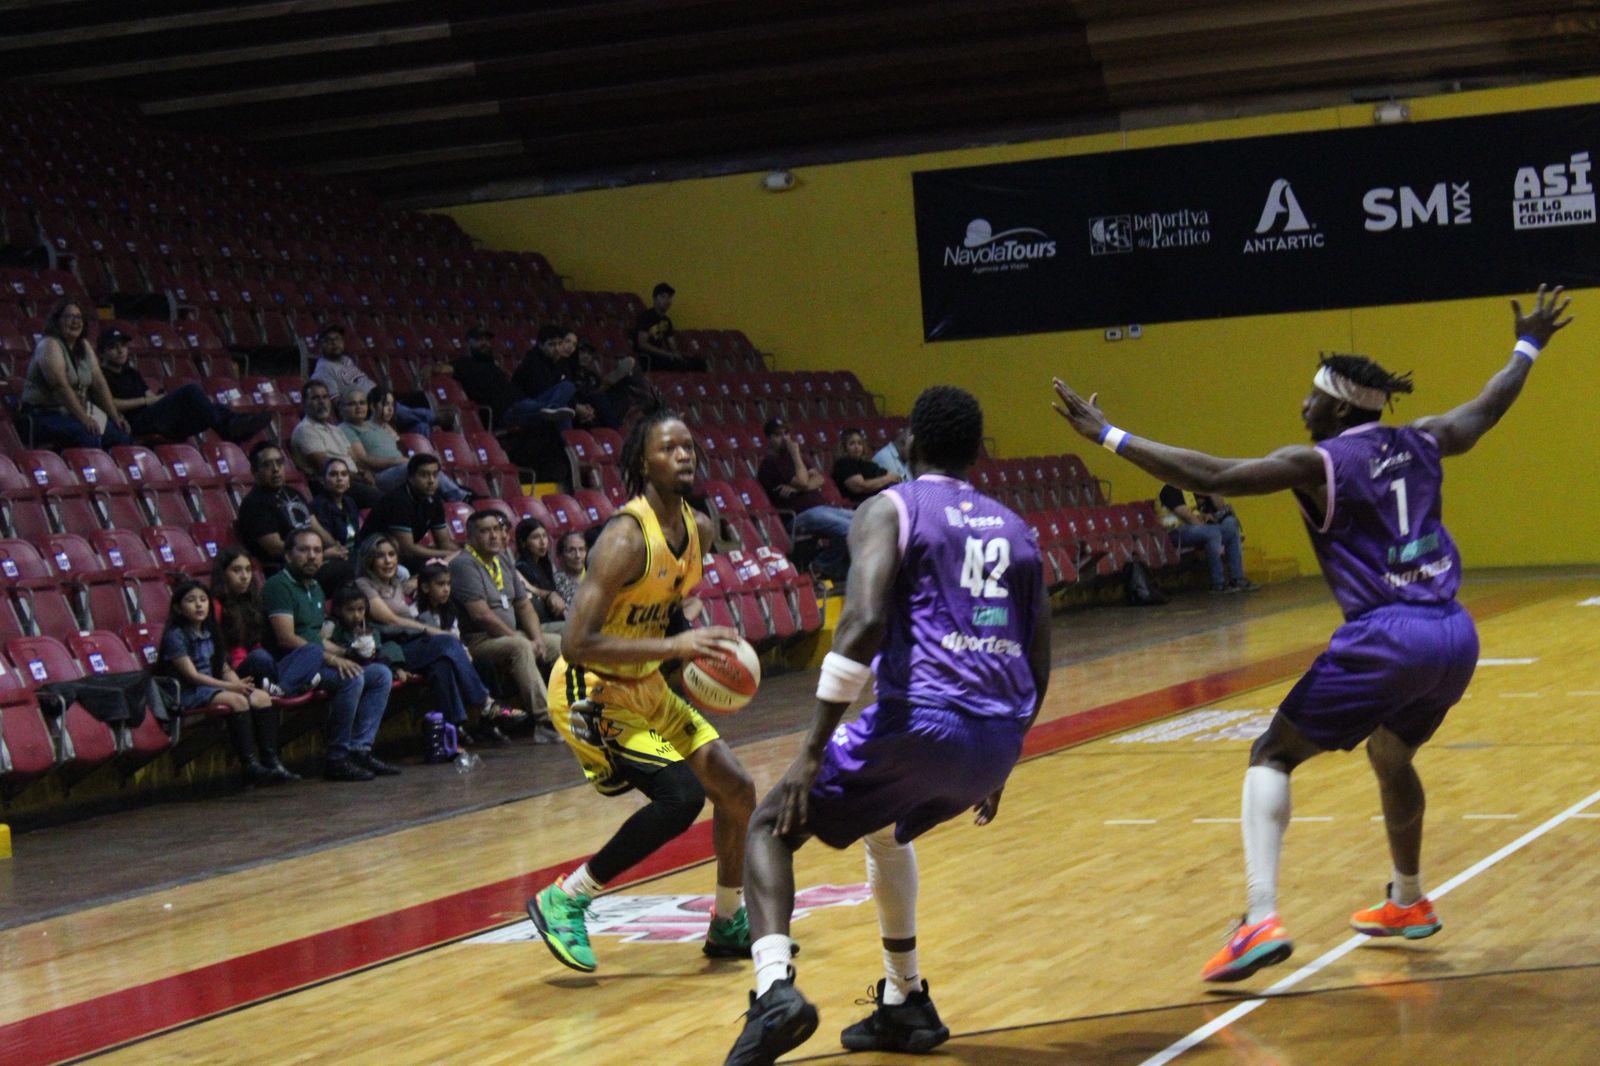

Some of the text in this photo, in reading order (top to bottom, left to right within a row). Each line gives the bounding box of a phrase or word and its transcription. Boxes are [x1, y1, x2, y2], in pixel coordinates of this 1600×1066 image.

[1362, 182, 1449, 232] SM
[1519, 200, 1562, 214] ME LO
[1519, 209, 1592, 226] CONTARON
[943, 240, 1057, 266] NavolaTours
[1243, 233, 1325, 254] ANTARTIC
[1390, 478, 1410, 537] 1
[960, 535, 1011, 598] 42
